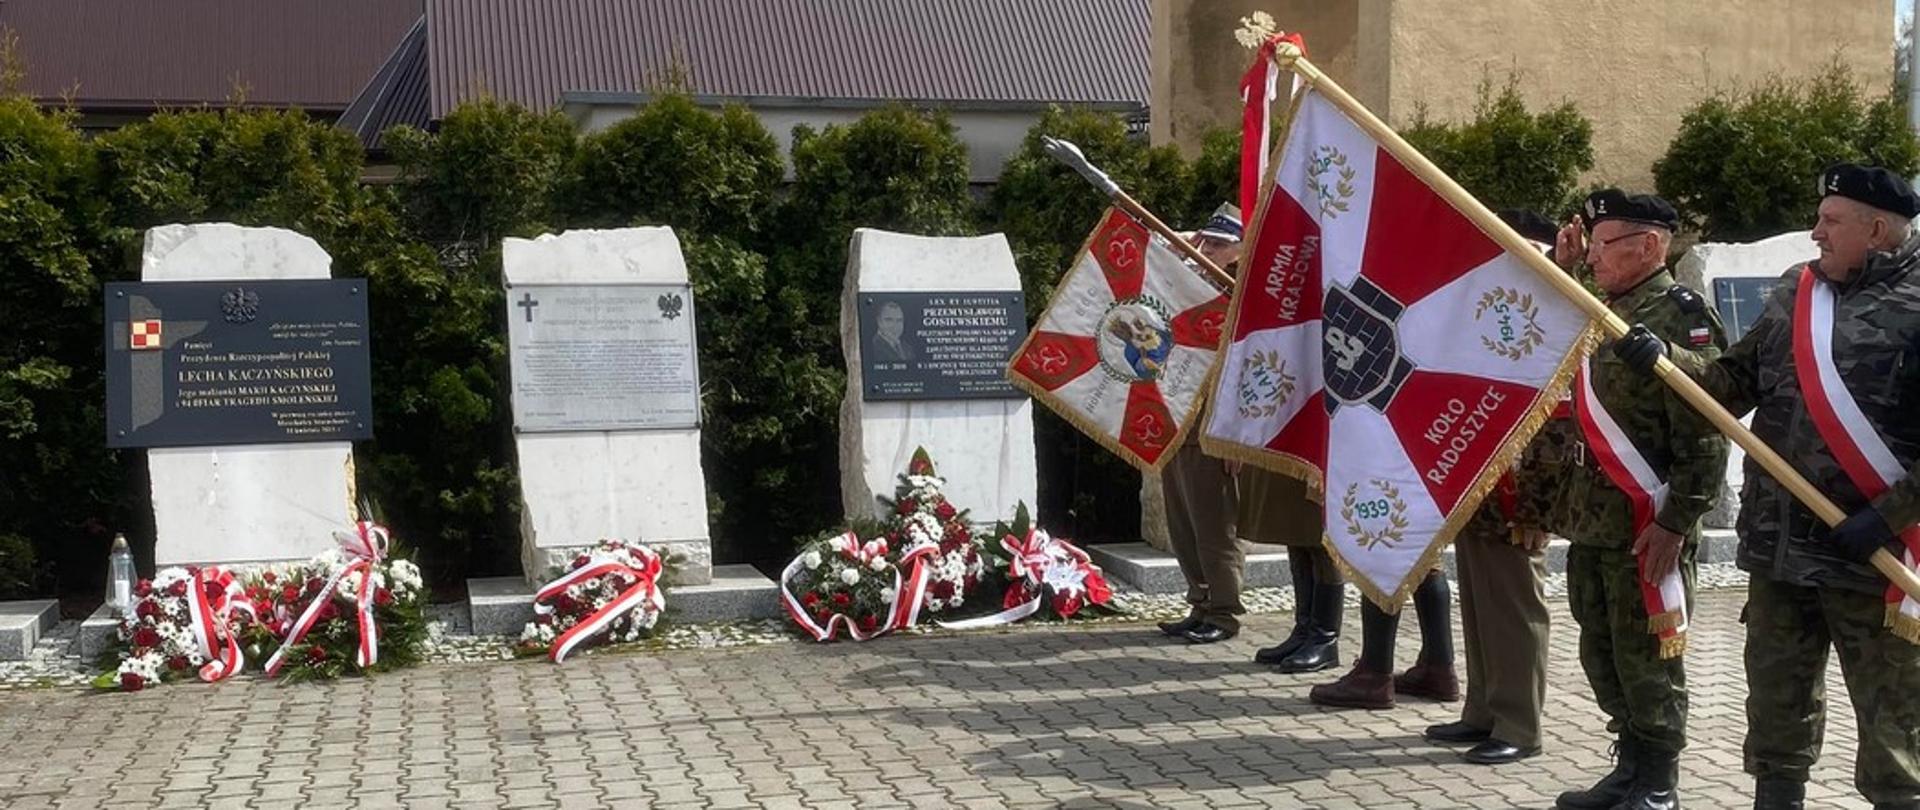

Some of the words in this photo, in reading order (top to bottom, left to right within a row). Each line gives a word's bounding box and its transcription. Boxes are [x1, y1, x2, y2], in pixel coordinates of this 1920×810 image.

[1264, 244, 1297, 299] ARMIA
[1278, 234, 1320, 321] KRAJOWA
[922, 317, 1009, 327] GOSIEWSKIEMU
[1494, 303, 1514, 342] 1945
[178, 369, 225, 383] LECHA
[228, 365, 334, 382] KACZYŃSKIEGO
[1423, 398, 1466, 446] KOŁO
[1426, 385, 1507, 485] RADOSZYCE
[1354, 498, 1389, 519] 1939
